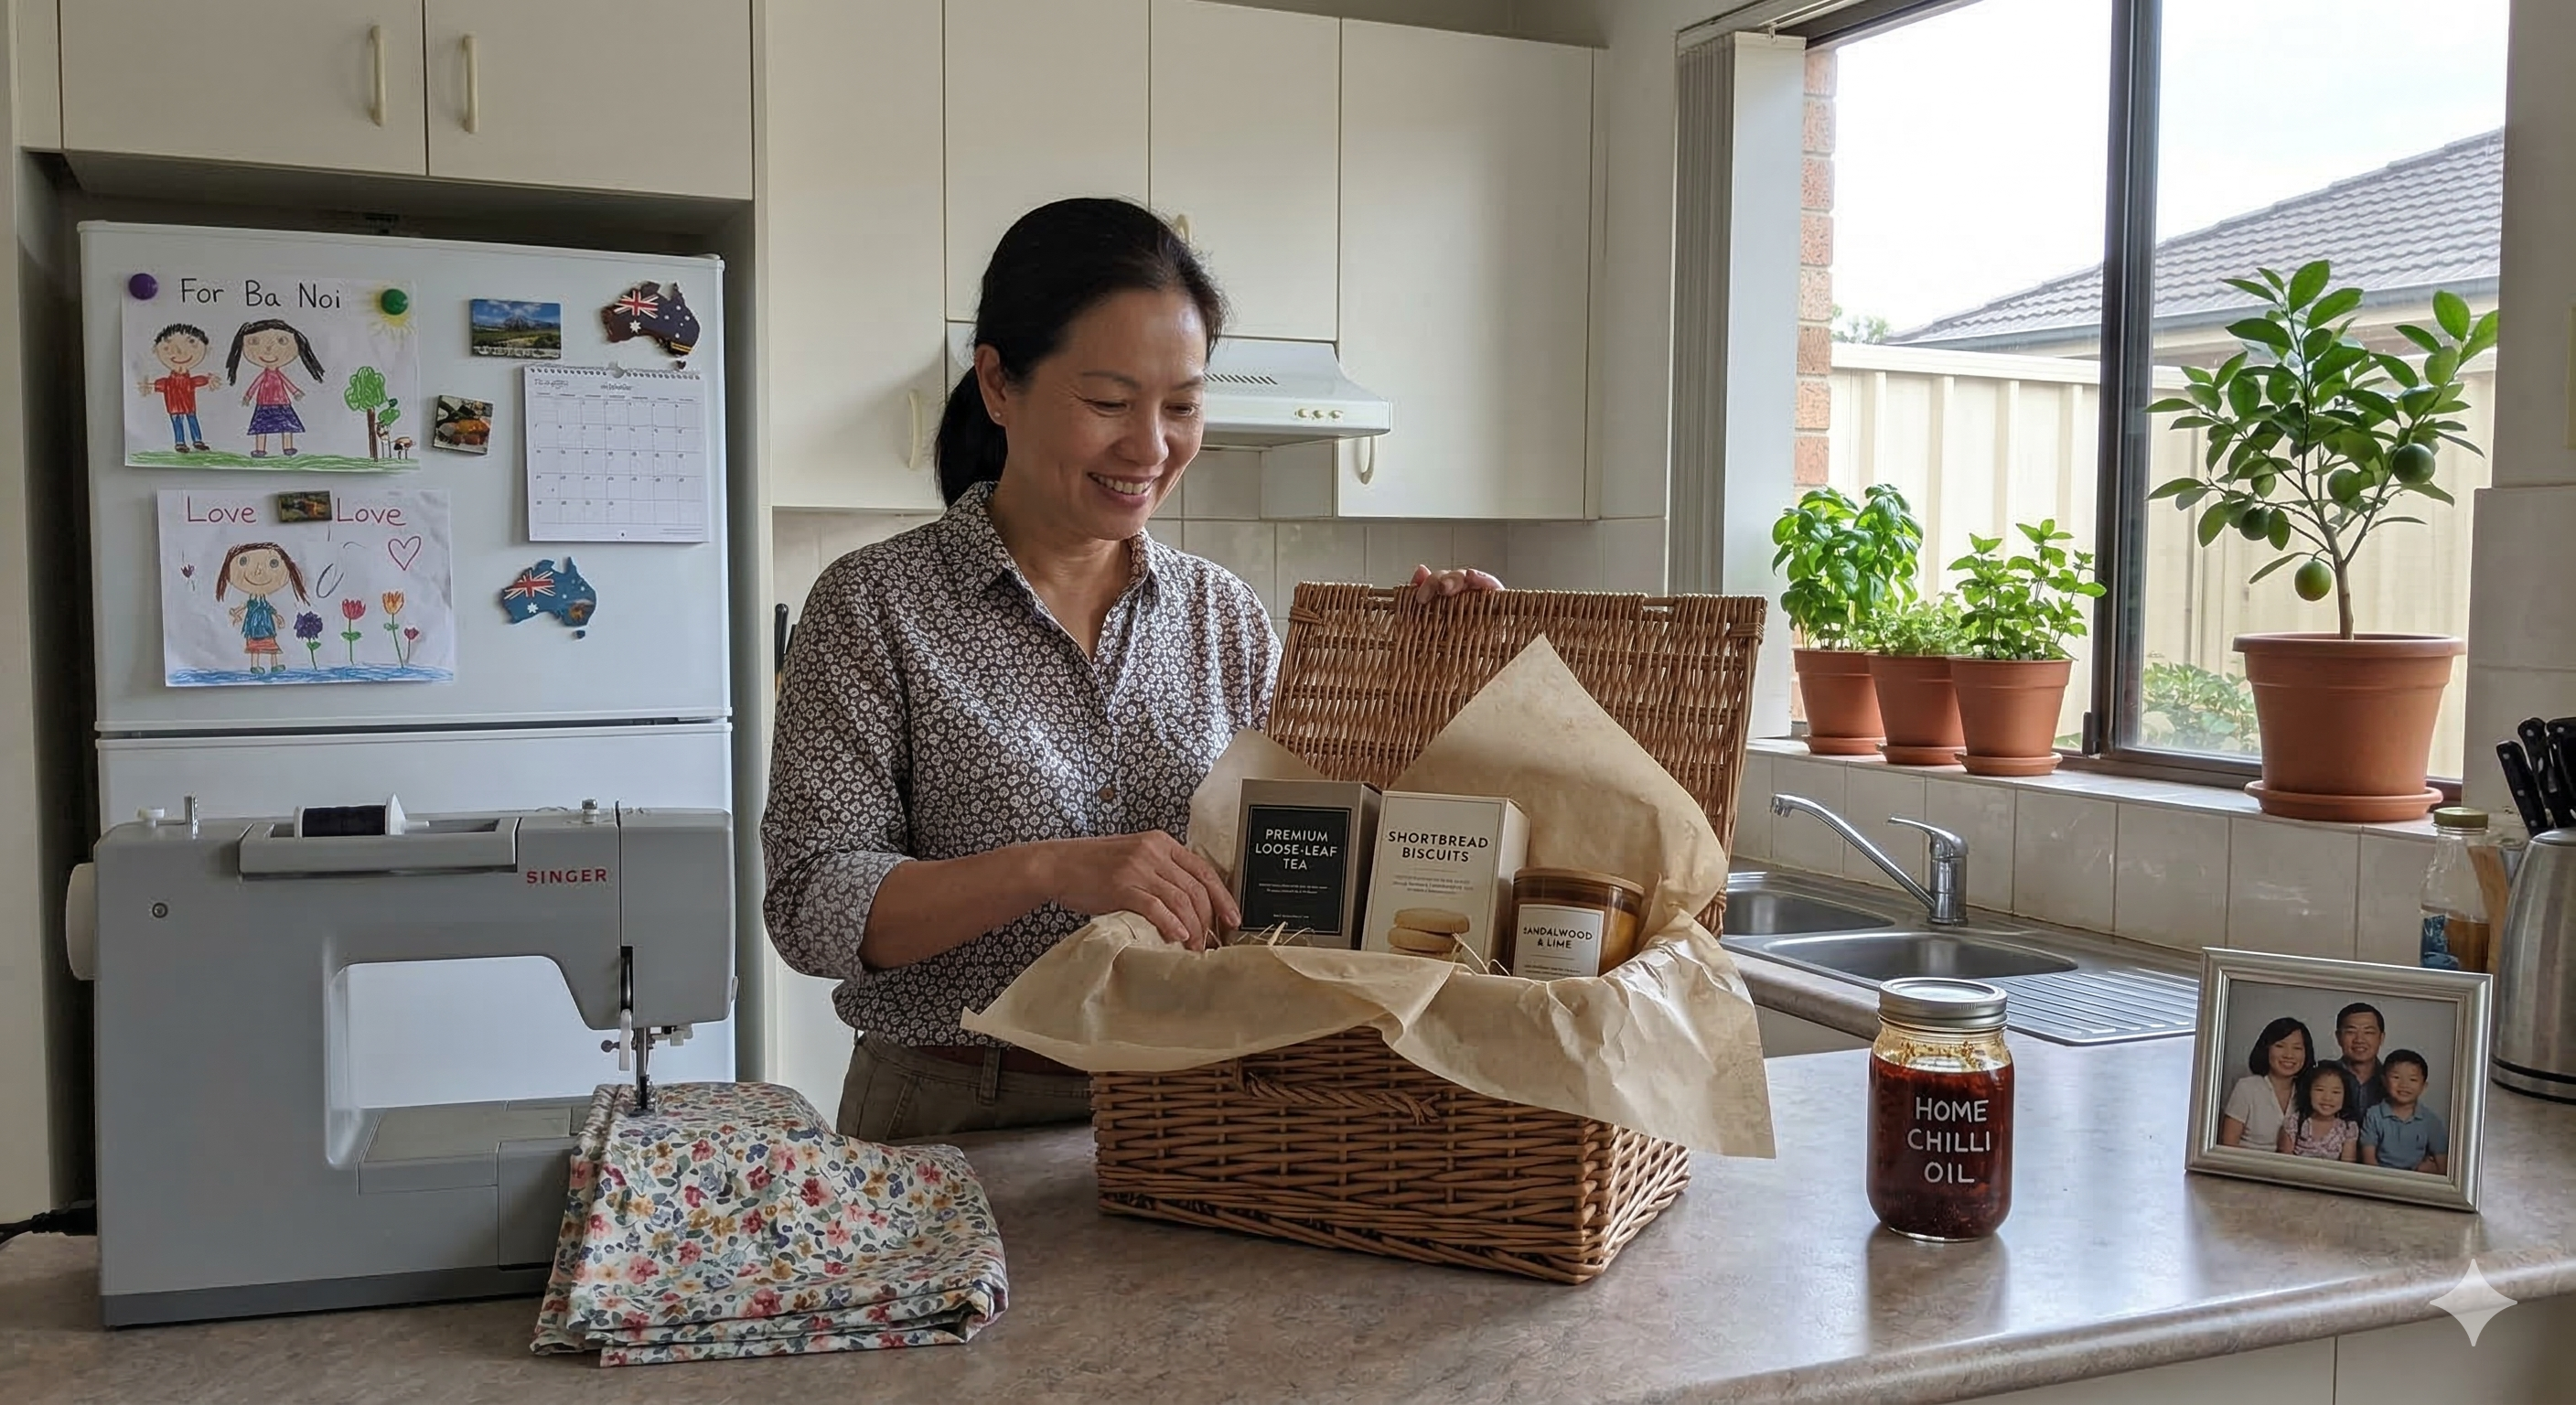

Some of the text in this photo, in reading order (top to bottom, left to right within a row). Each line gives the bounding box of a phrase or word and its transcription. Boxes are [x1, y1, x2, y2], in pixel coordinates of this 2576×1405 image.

[180, 277, 340, 309] For Ba Noi
[187, 496, 407, 526] Love Love
[1265, 829, 1328, 842] PREMIUM
[1388, 831, 1488, 849] SHORTBREAD
[1283, 858, 1307, 870] TEA
[1401, 847, 1469, 863] BISCUITS
[526, 868, 607, 885] SINGER
[1547, 938, 1572, 949] LIME
[1916, 1097, 1989, 1122] HOME
[1907, 1128, 1991, 1153] CHILLI
[1924, 1162, 1975, 1184] OIL
